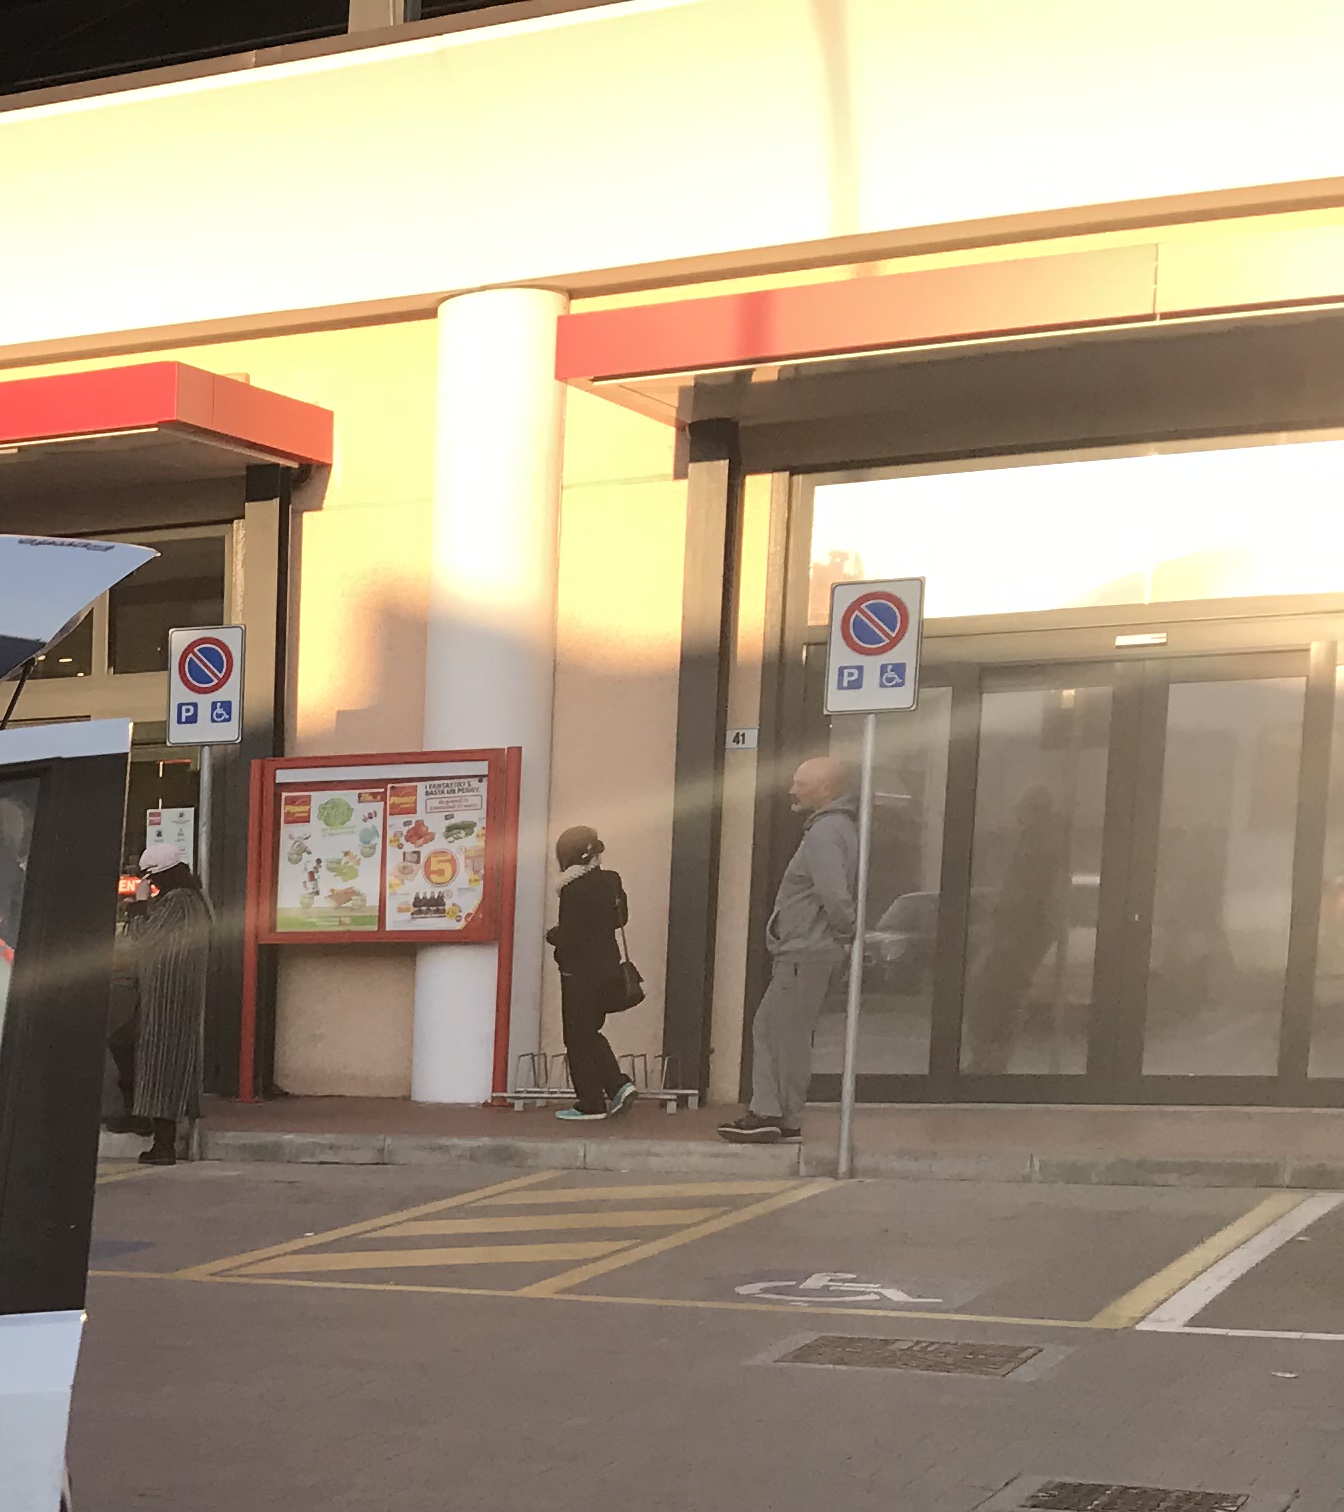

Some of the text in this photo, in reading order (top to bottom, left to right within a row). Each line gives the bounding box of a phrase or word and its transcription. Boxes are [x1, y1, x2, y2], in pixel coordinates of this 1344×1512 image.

[843, 668, 859, 687] P
[181, 705, 194, 722] P
[732, 731, 746, 745] 41
[430, 853, 452, 885] 5
